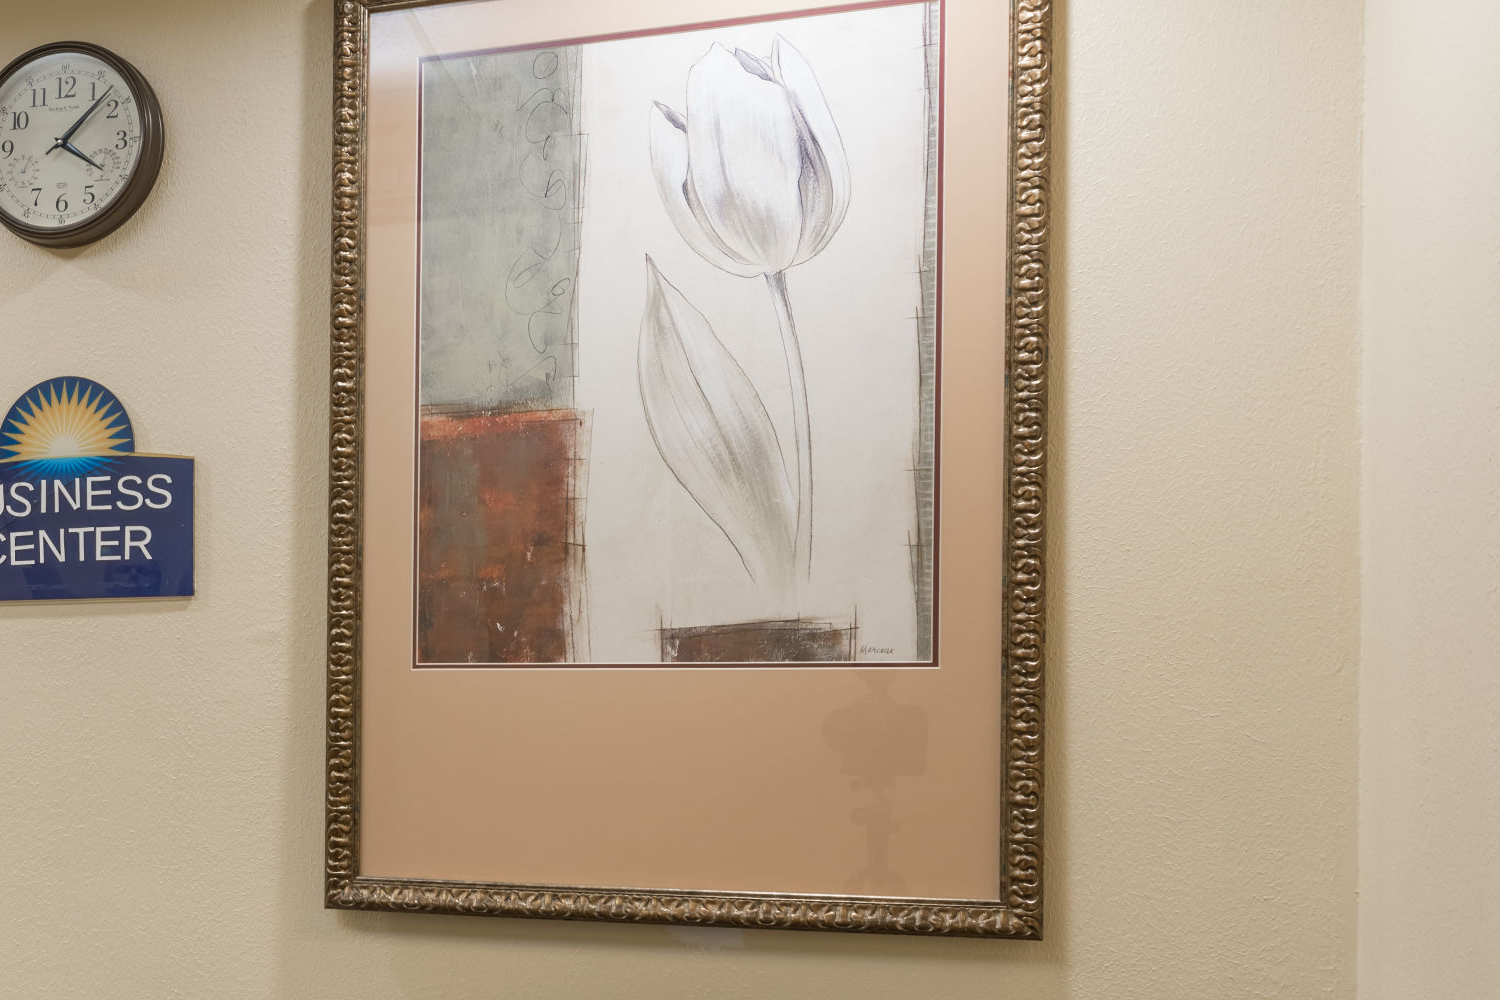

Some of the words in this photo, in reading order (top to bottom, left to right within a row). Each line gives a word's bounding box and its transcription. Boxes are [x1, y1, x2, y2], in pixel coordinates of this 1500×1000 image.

[29, 88, 48, 108] 11
[54, 76, 77, 100] 12
[88, 82, 100, 101] 1
[106, 99, 119, 119] 2
[9, 111, 29, 130] 10
[1, 140, 14, 160] 9
[115, 130, 128, 150] 3
[31, 188, 42, 207] 7
[55, 193, 68, 213] 6
[82, 185, 95, 205] 5
